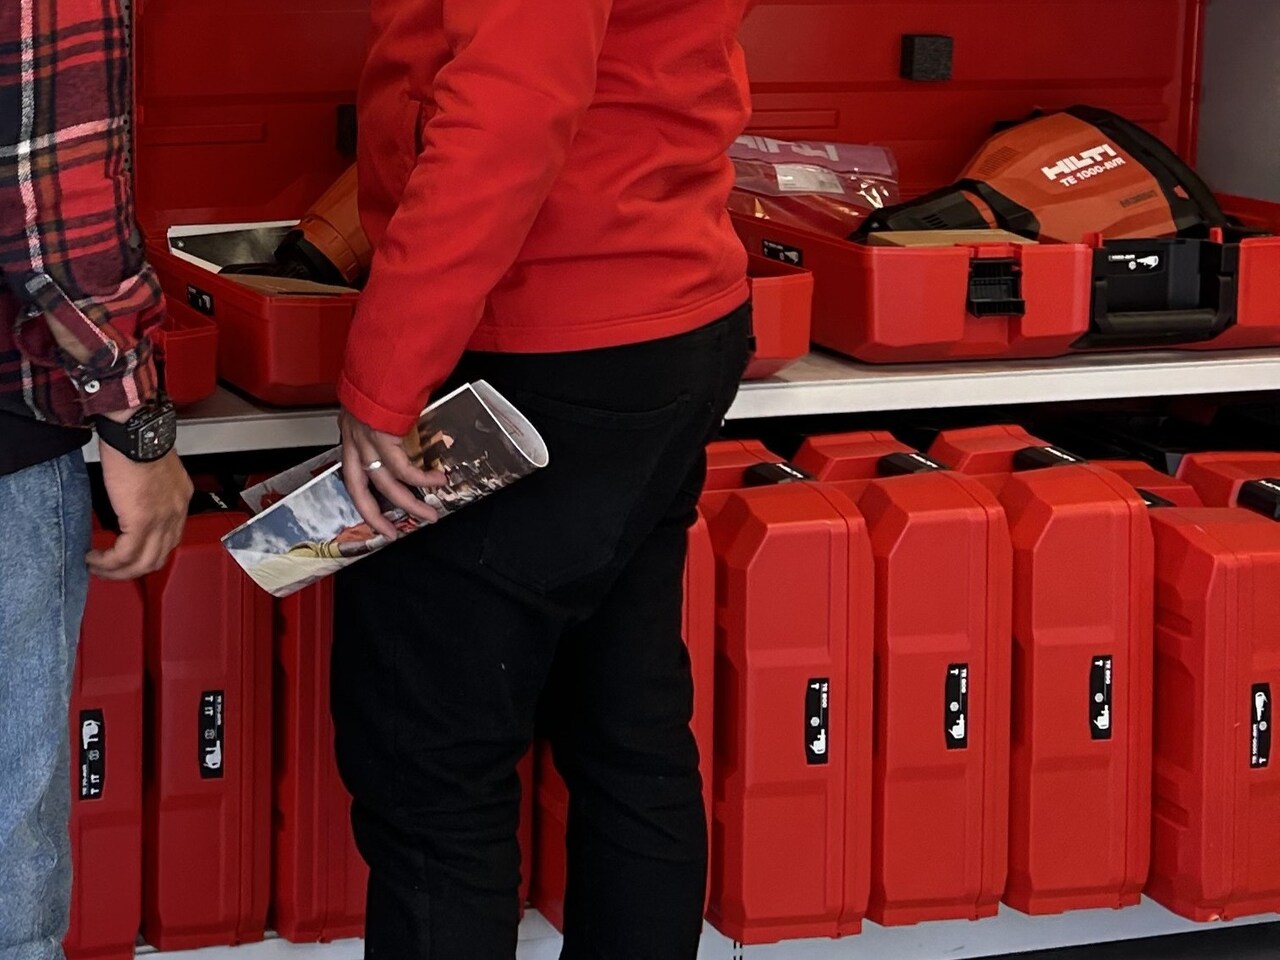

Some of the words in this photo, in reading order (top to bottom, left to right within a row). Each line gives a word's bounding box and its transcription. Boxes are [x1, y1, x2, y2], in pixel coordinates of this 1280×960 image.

[1041, 143, 1117, 181] HILTI
[1059, 175, 1078, 187] TE
[1076, 157, 1126, 180] 1000-AVR
